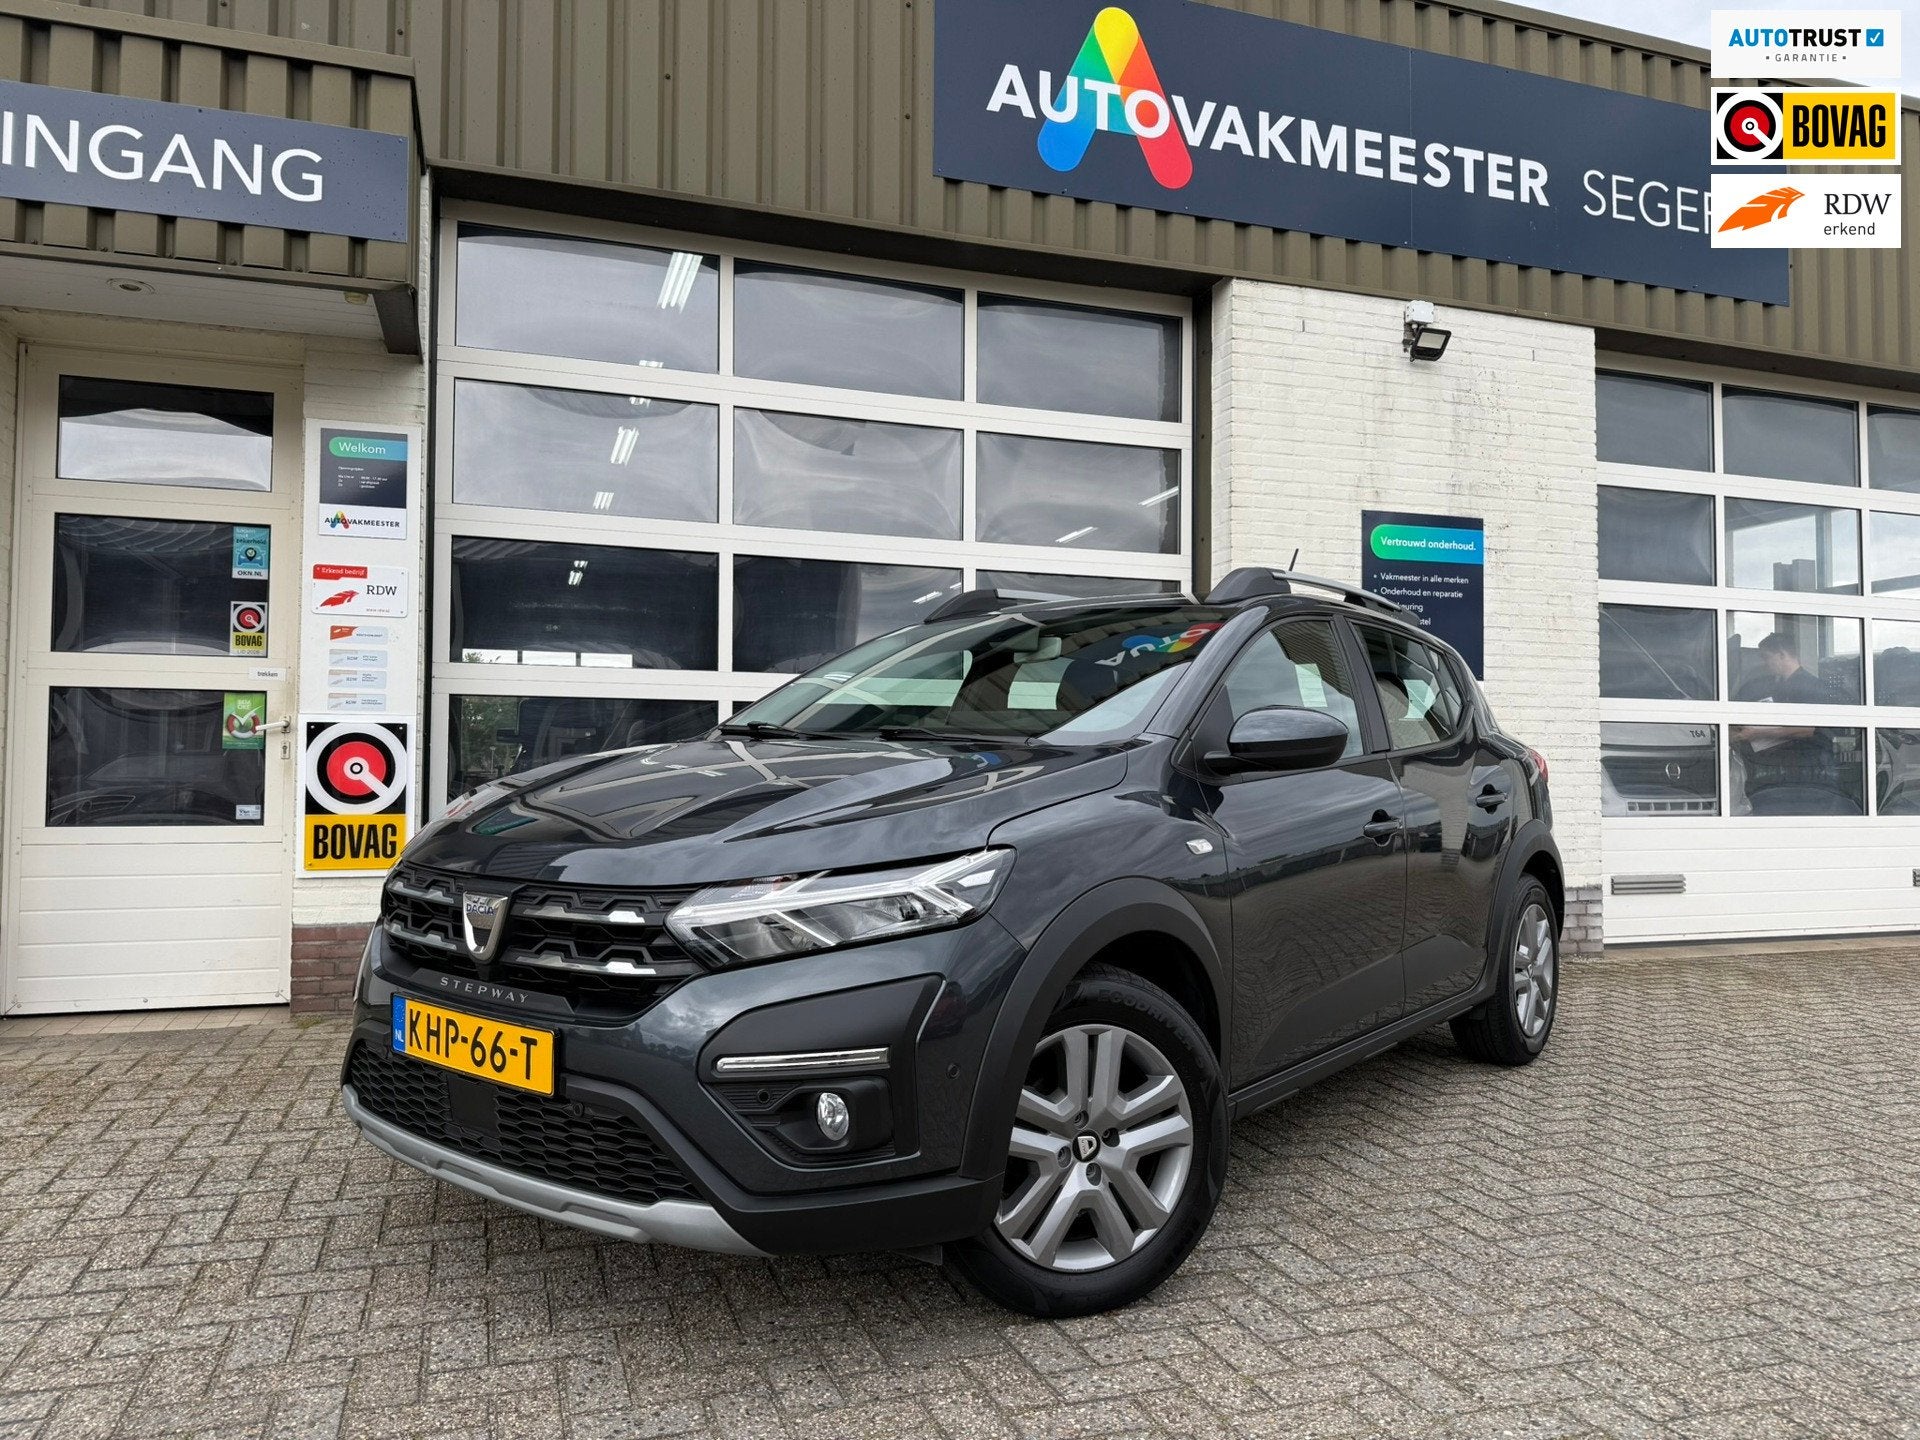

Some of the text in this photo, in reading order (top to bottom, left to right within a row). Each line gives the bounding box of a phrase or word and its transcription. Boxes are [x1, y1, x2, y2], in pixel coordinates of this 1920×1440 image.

[986, 63, 1550, 206] AUTOVAKMEESTER
[1, 111, 324, 202] INGANG
[339, 442, 386, 454] Welkom
[324, 516, 400, 528] AUTOVAKMEESTER
[1380, 536, 1476, 551] Vertrouwd onderhoud.
[1380, 573, 1421, 582] Vakmeester
[1430, 575, 1442, 583] alle
[1443, 576, 1469, 585] merken
[366, 584, 397, 596] RDW
[1380, 586, 1463, 599] Onderhoud en reparatie
[235, 634, 263, 647] BOVAG
[313, 823, 397, 860] BOVAG
[466, 903, 494, 915] DACIA
[440, 976, 528, 1003] STEPWAY
[409, 1008, 538, 1080] KHP-66-T
